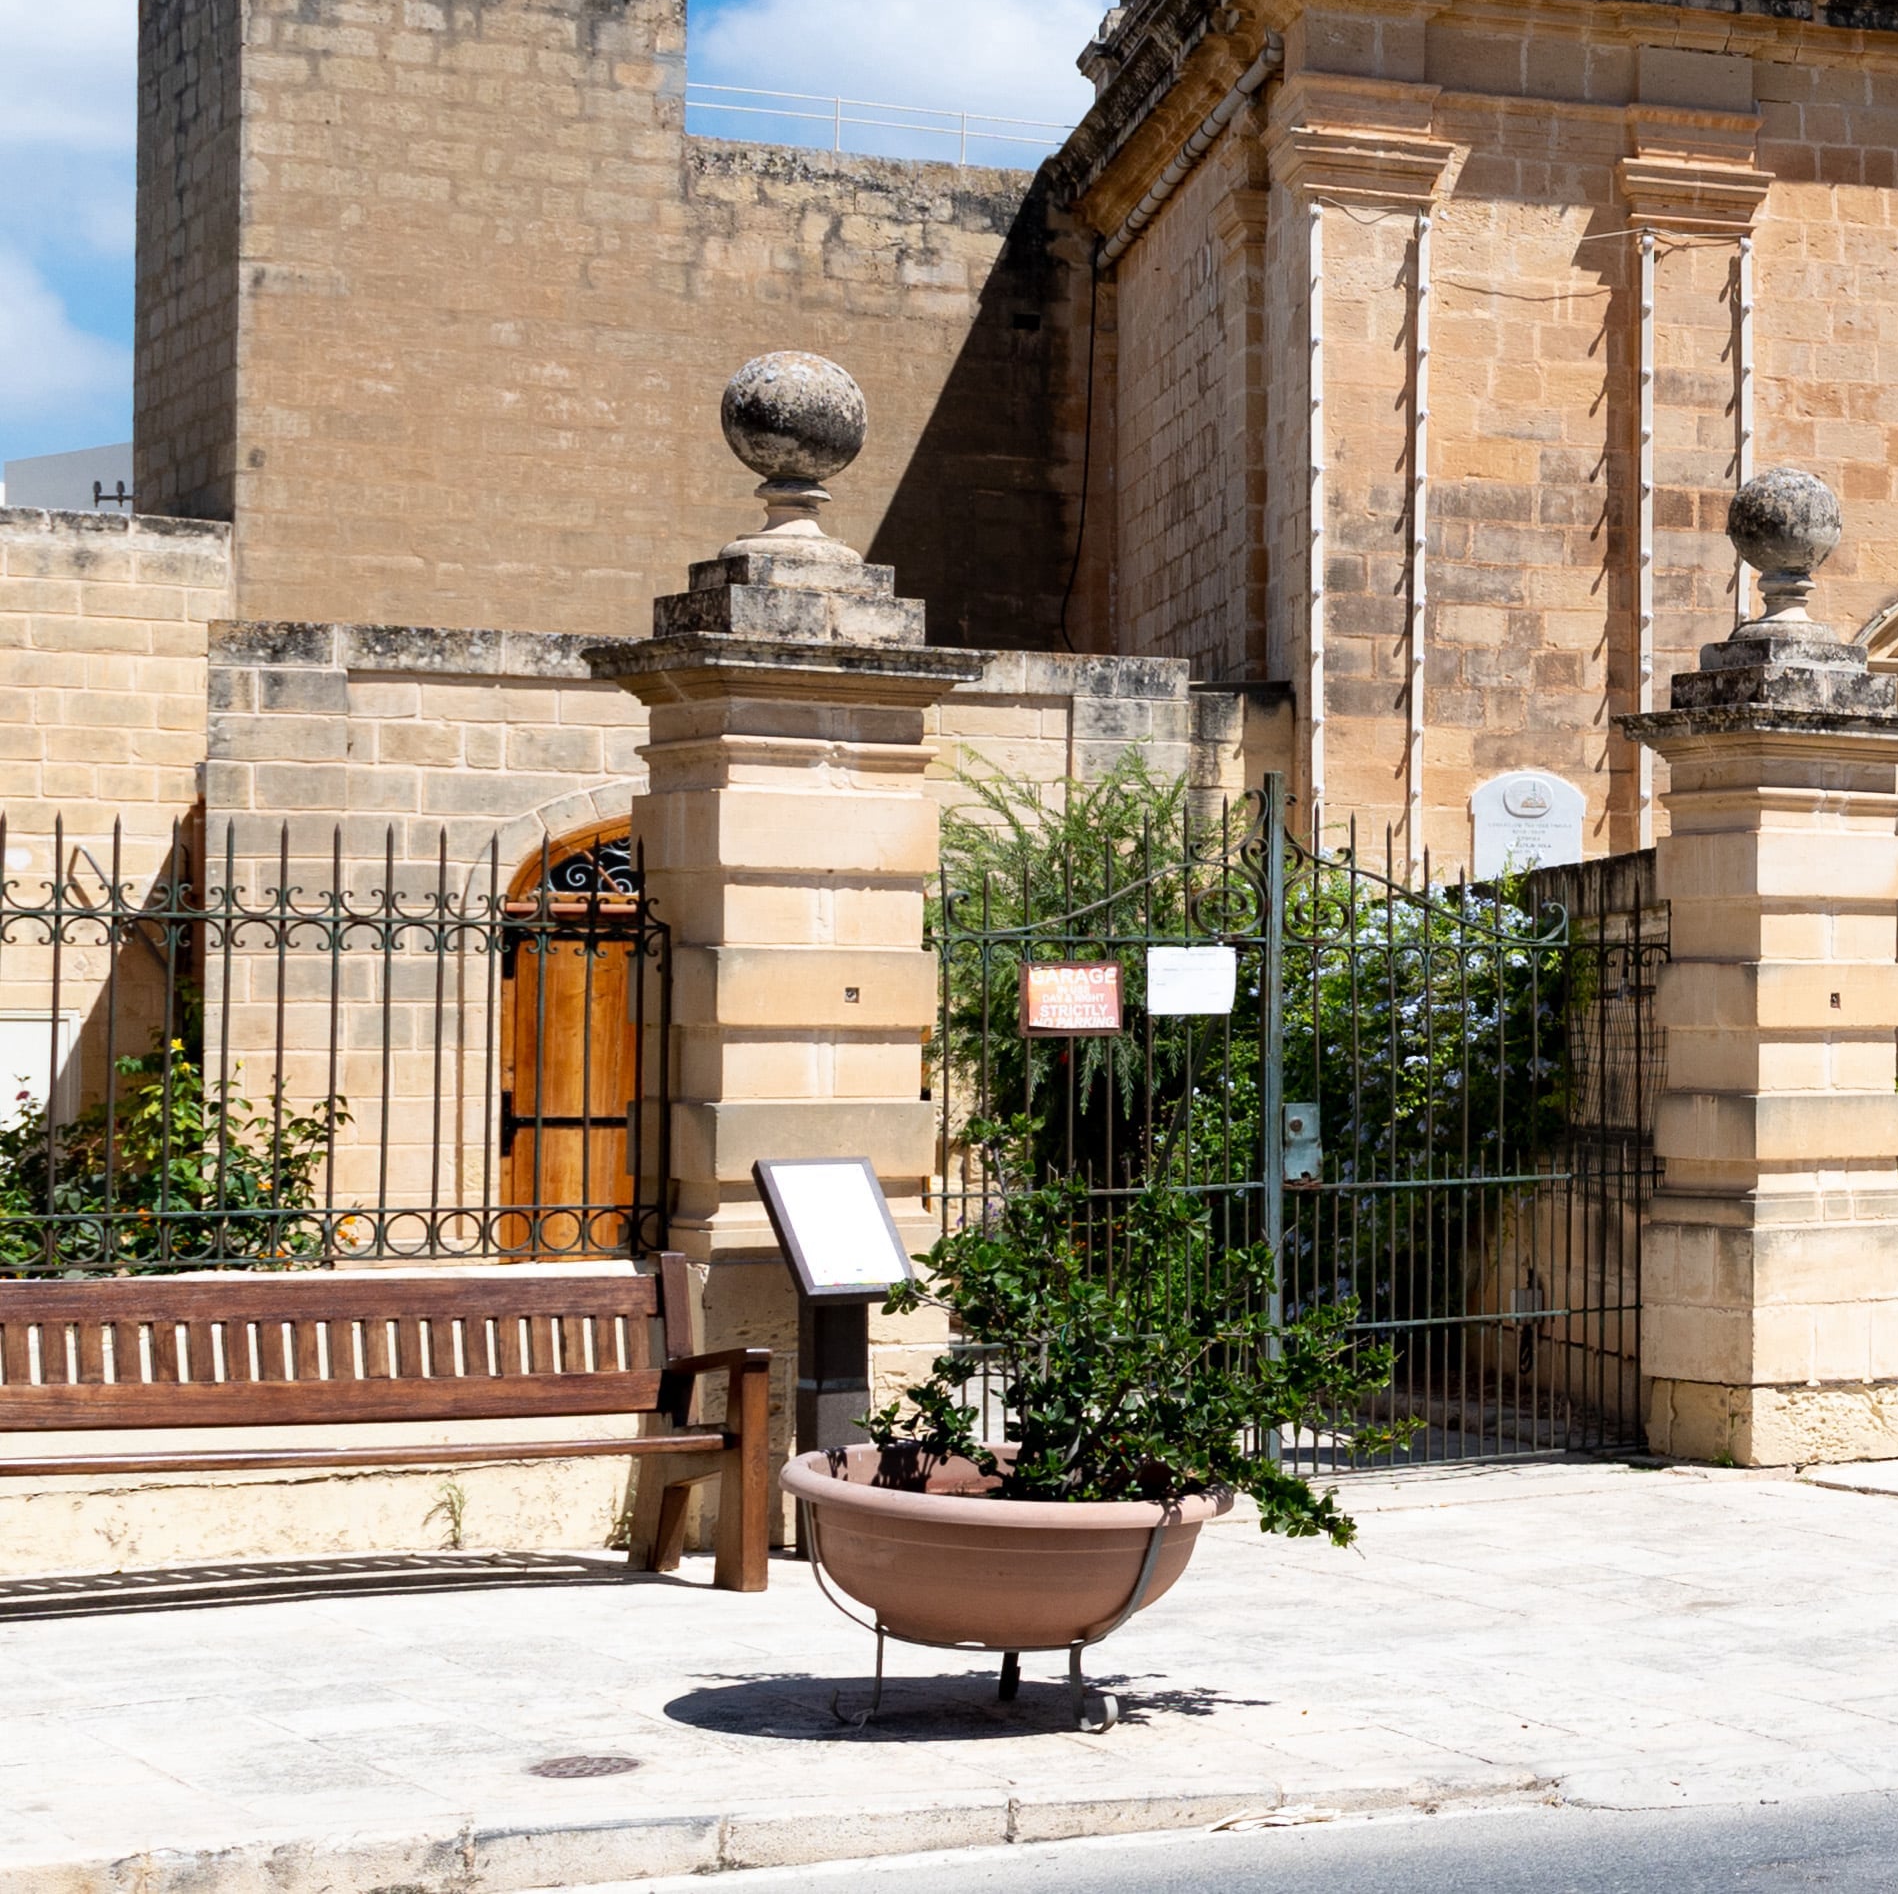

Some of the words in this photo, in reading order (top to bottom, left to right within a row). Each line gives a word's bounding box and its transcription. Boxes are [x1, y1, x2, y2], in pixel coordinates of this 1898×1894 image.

[1029, 967, 1117, 984] GARAGE
[1057, 986, 1068, 994] IN
[1070, 985, 1090, 994] USE
[1042, 994, 1062, 1003] DAY
[1064, 994, 1073, 1003] &
[1074, 993, 1105, 1003] NIGHT
[1040, 1004, 1108, 1017] STRICTLY
[1033, 1017, 1053, 1027] NO
[1056, 1016, 1115, 1028] PARKING
